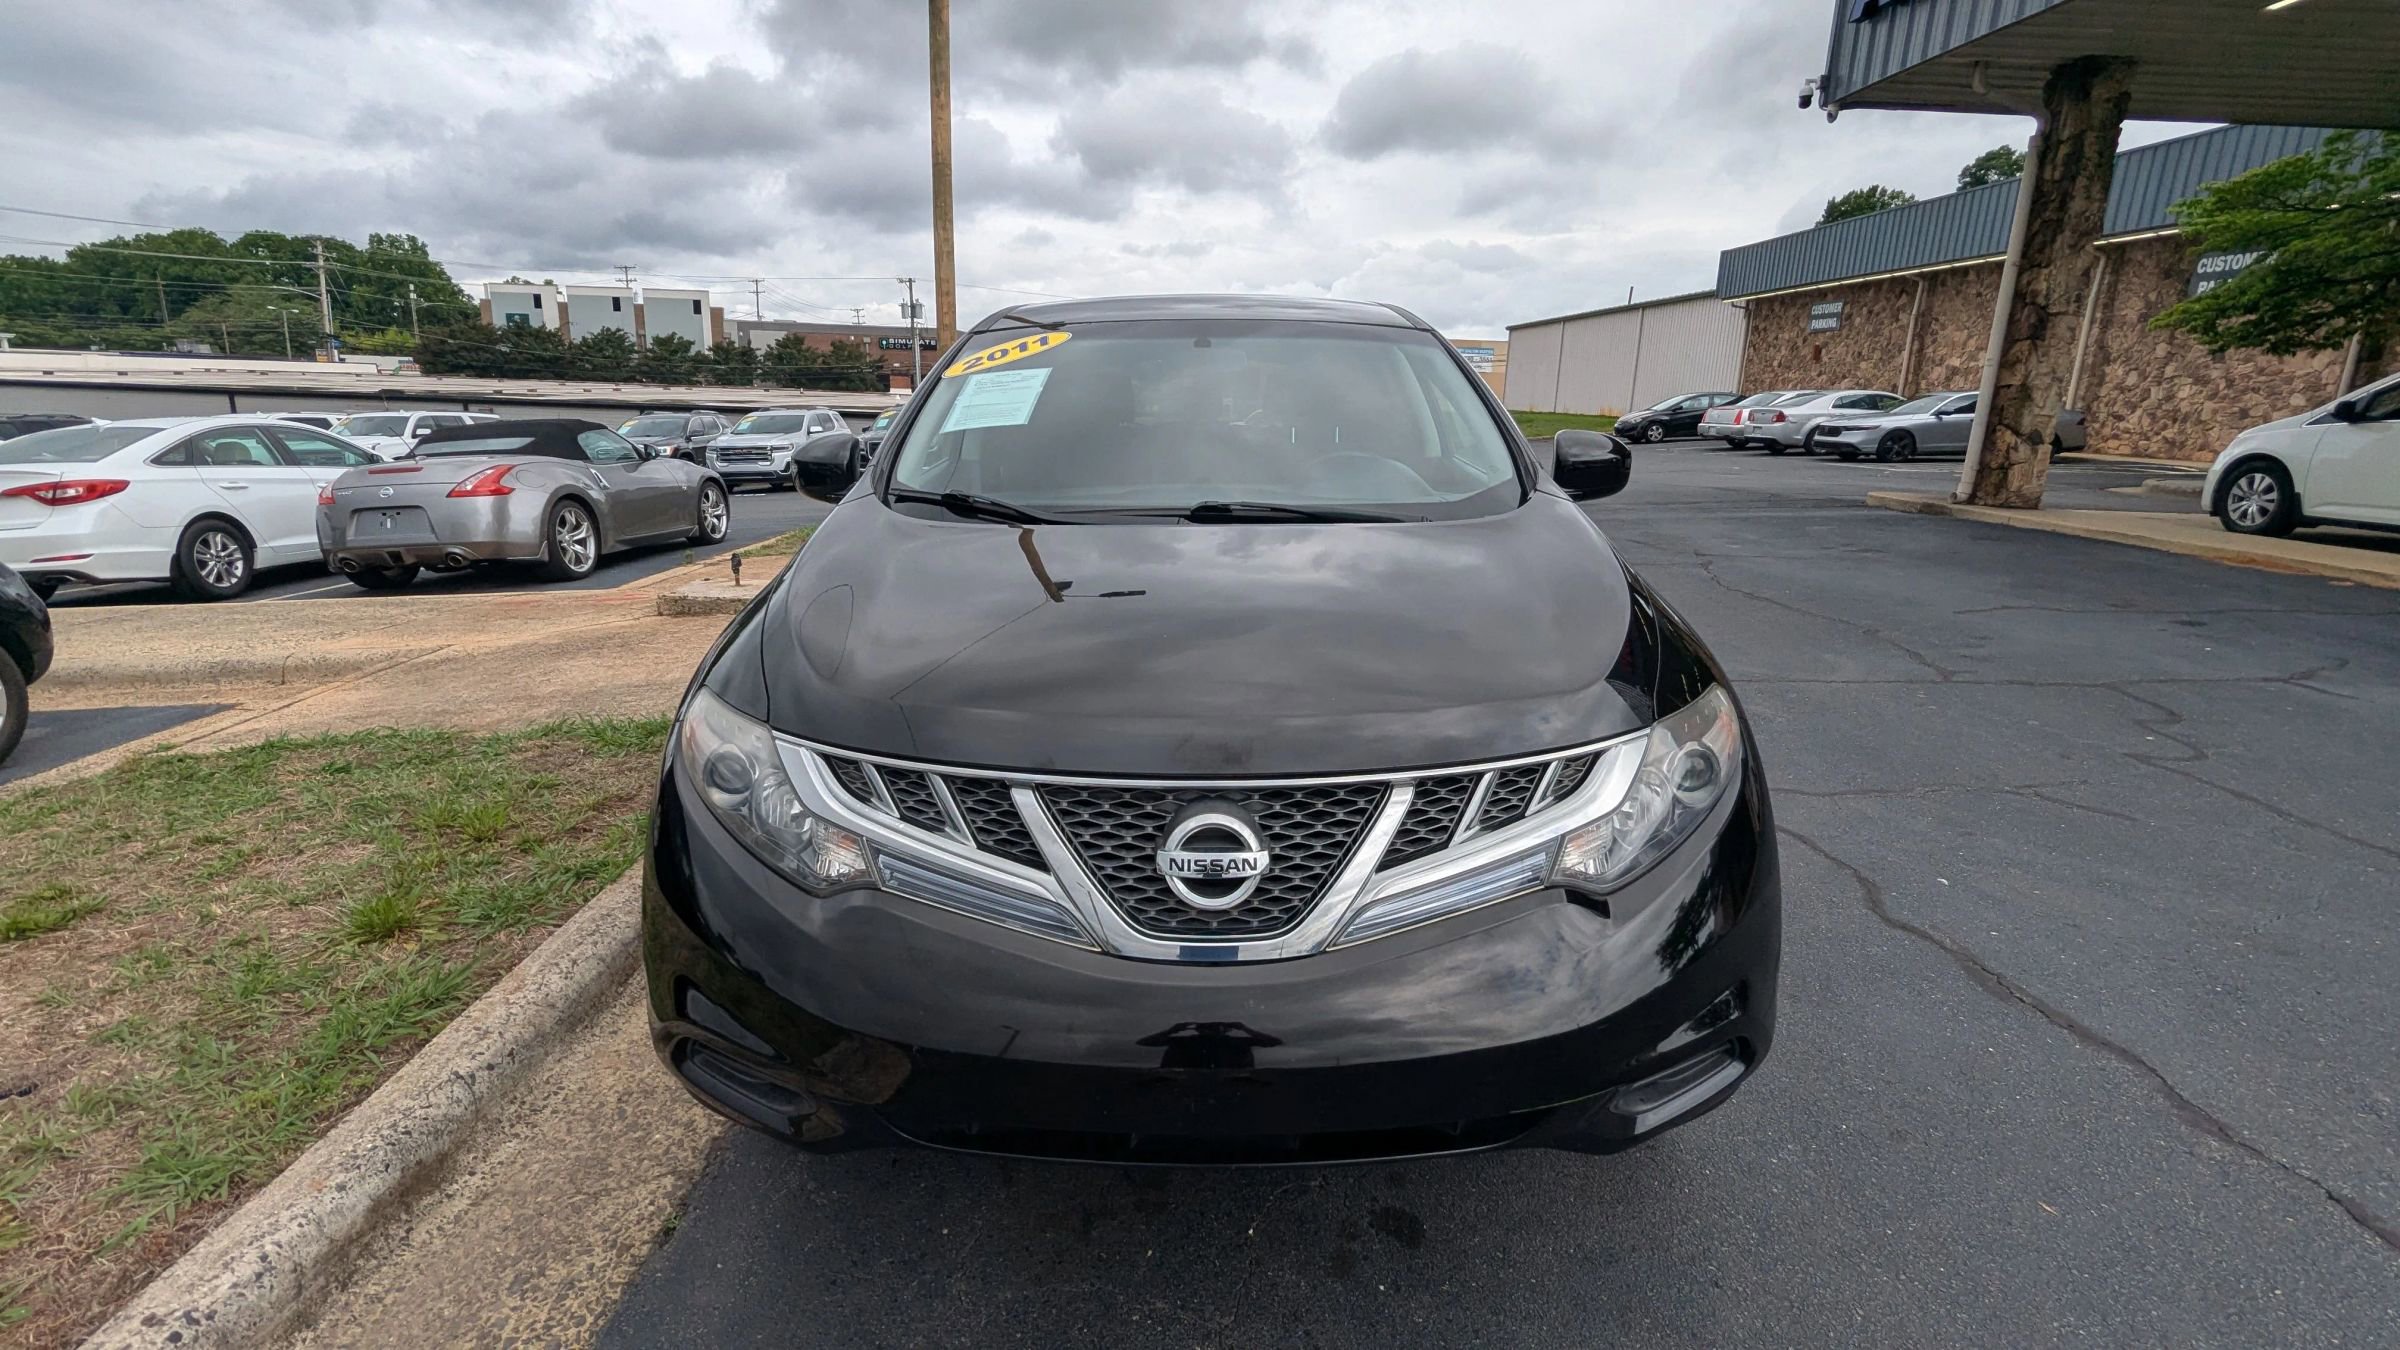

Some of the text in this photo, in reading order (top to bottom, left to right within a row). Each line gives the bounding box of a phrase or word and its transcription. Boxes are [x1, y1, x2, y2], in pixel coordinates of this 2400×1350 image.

[2197, 250, 2280, 274] CUSTOM
[1811, 302, 1842, 315] CUSTOMER
[1810, 317, 1838, 330] PARKING
[888, 338, 937, 346] SIMUATE
[961, 335, 1049, 372] 2011
[1169, 857, 1258, 873] NISSAN
